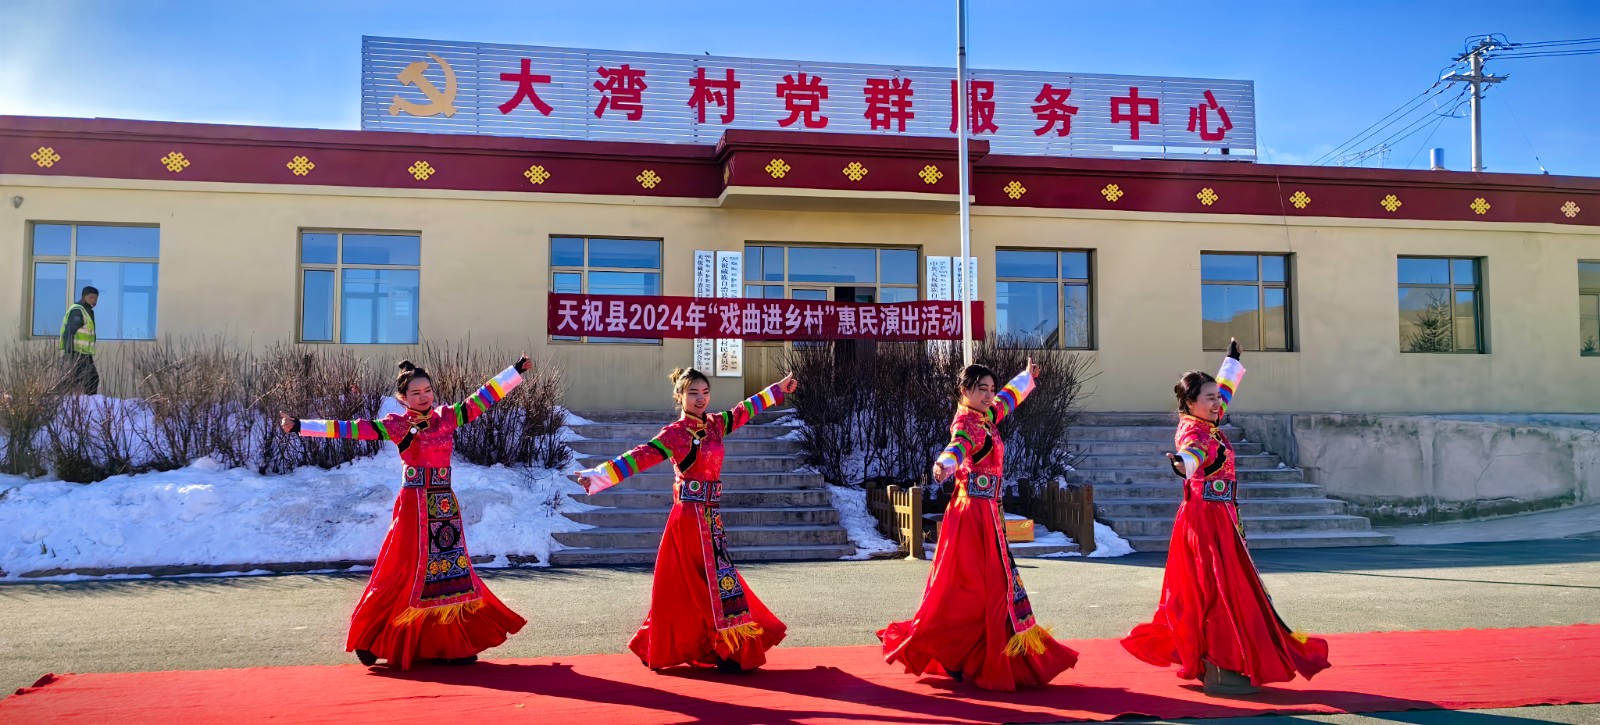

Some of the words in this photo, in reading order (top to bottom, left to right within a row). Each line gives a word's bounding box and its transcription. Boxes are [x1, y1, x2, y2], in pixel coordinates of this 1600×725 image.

[499, 59, 1232, 141] 大湾村党群服务中心
[556, 299, 961, 336] 天祝县2024年“戏曲进乡村”惠民演出活动
